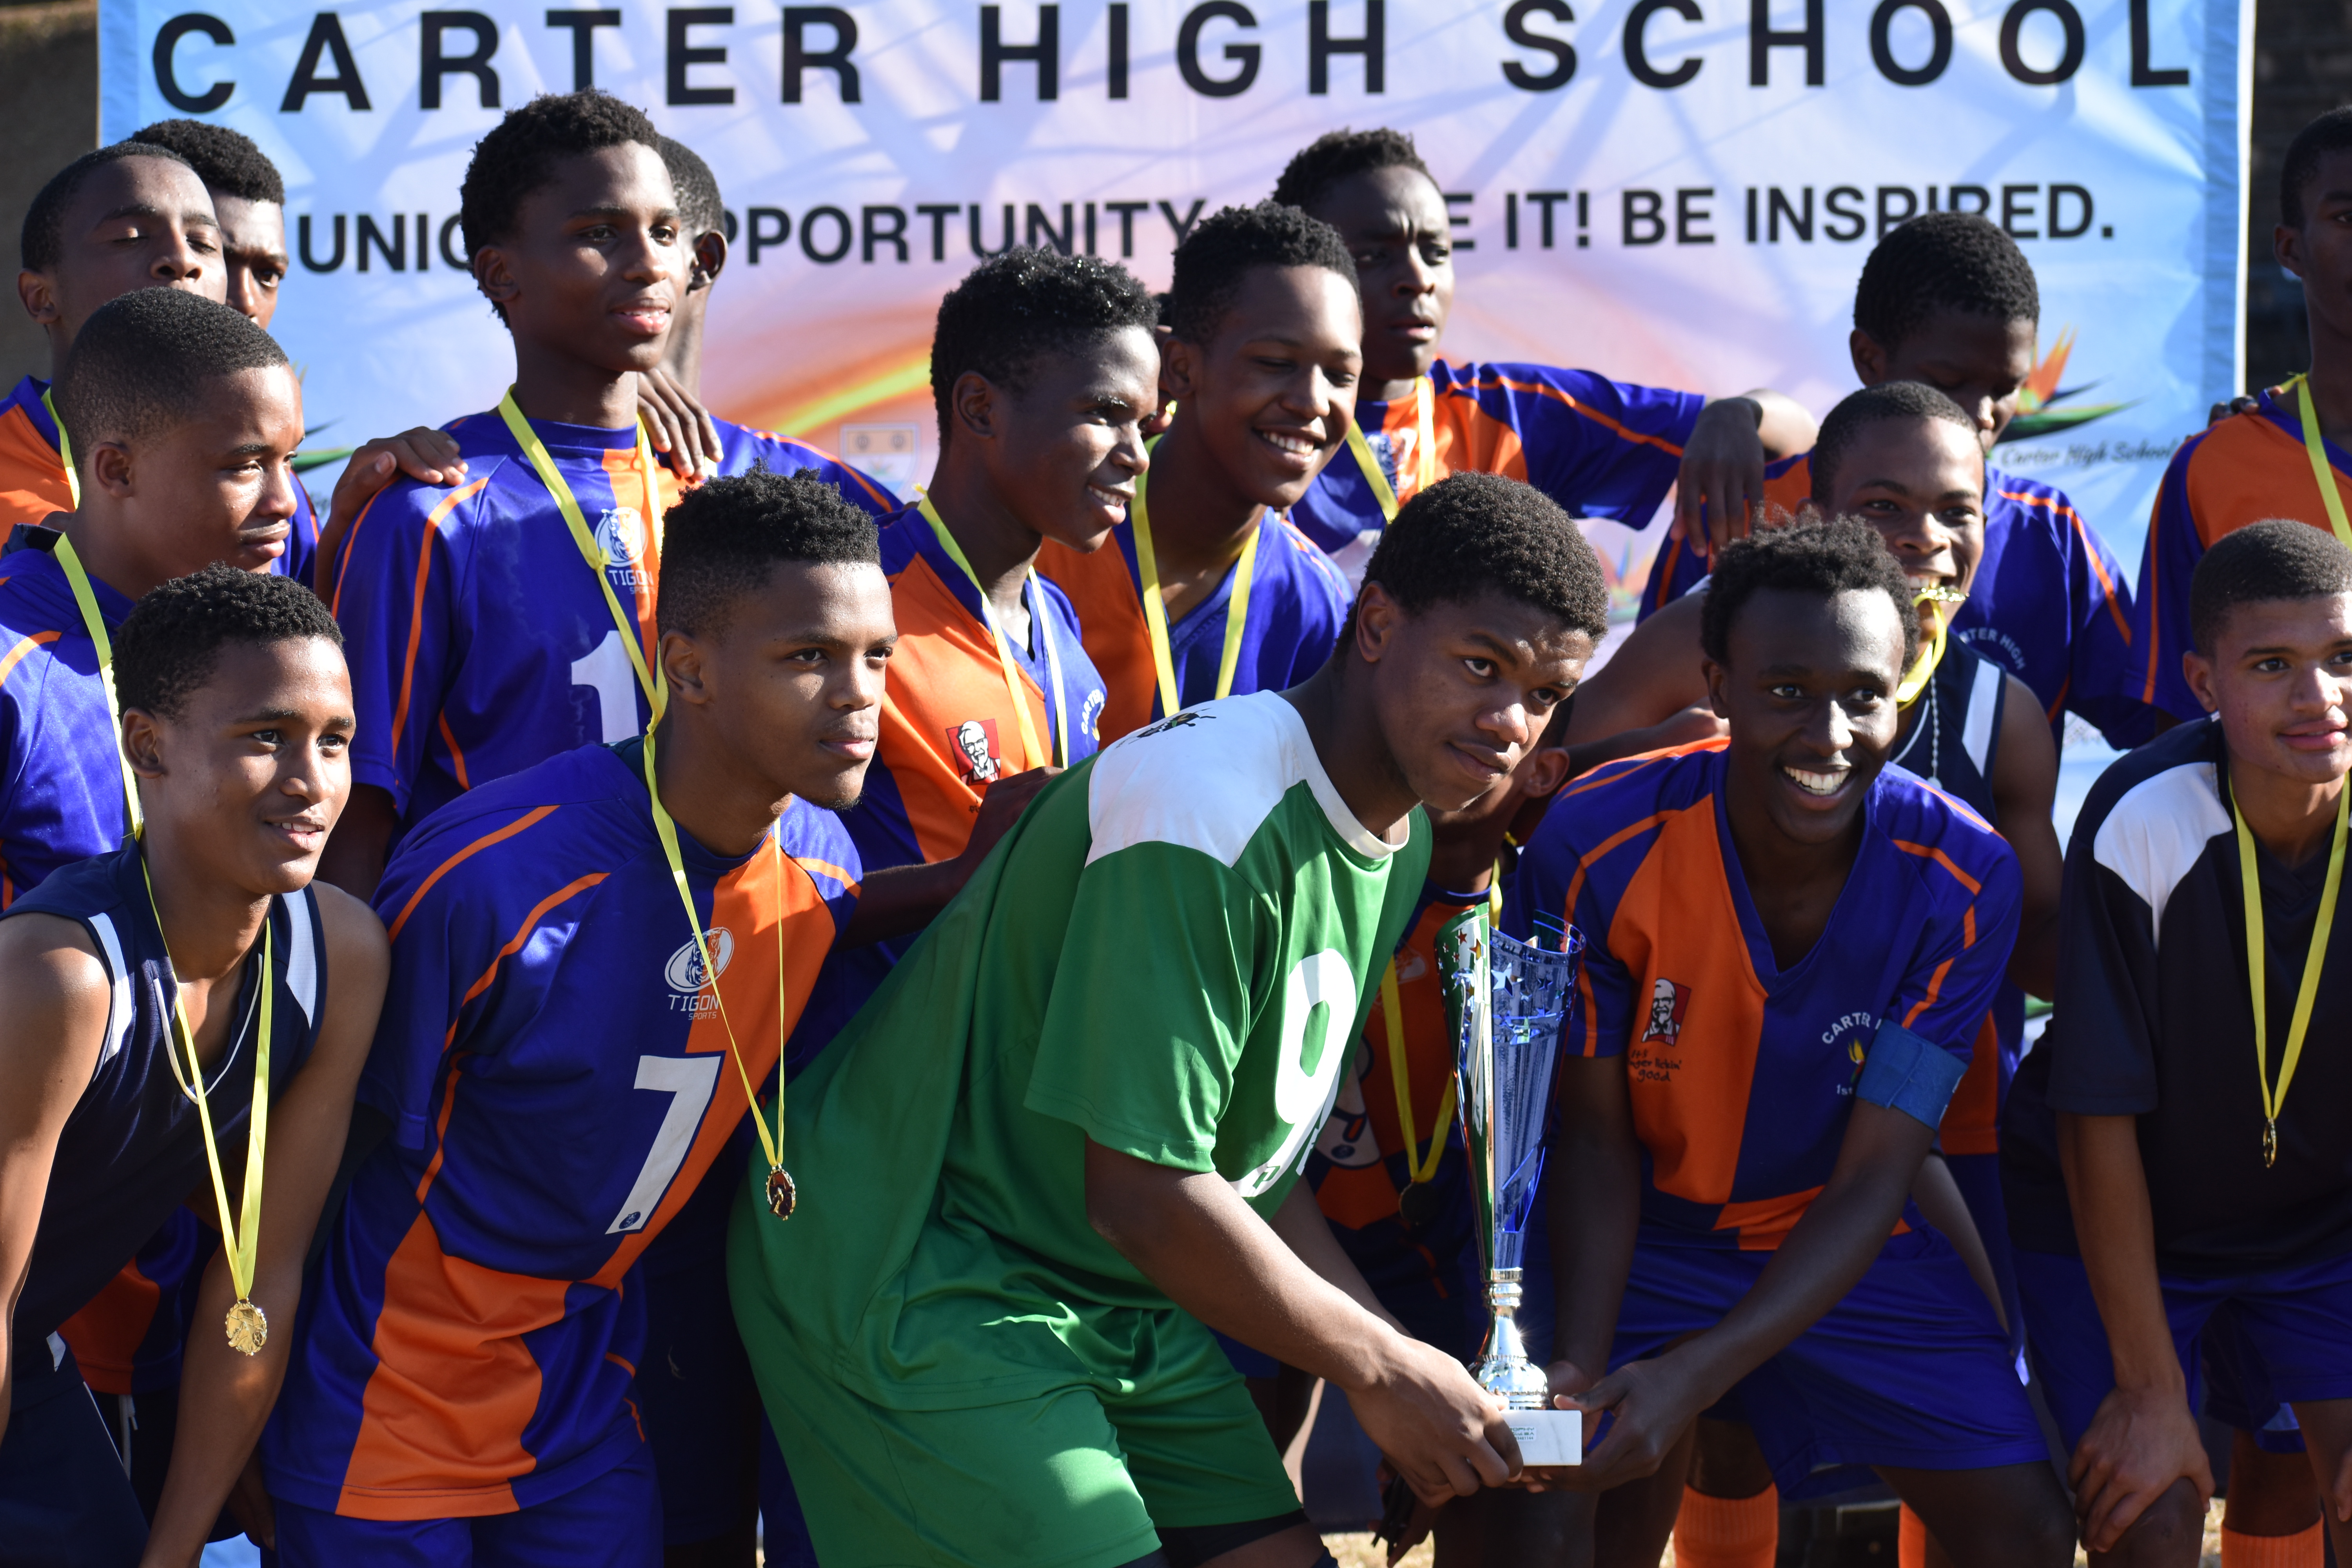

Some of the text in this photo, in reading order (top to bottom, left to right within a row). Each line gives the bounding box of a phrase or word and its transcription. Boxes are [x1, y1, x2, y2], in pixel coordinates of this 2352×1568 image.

[152, 0, 2190, 114] CARTER HIGH SCHOOL
[1505, 191, 1590, 249] IT!
[1622, 187, 1715, 248] BE
[608, 570, 654, 586] TIGON
[668, 994, 720, 1011] TIGON
[688, 1011, 717, 1020] SPORTS
[1637, 1069, 1671, 1082] good
[1836, 1084, 1853, 1096] 1st
[605, 1055, 721, 1235] 7
